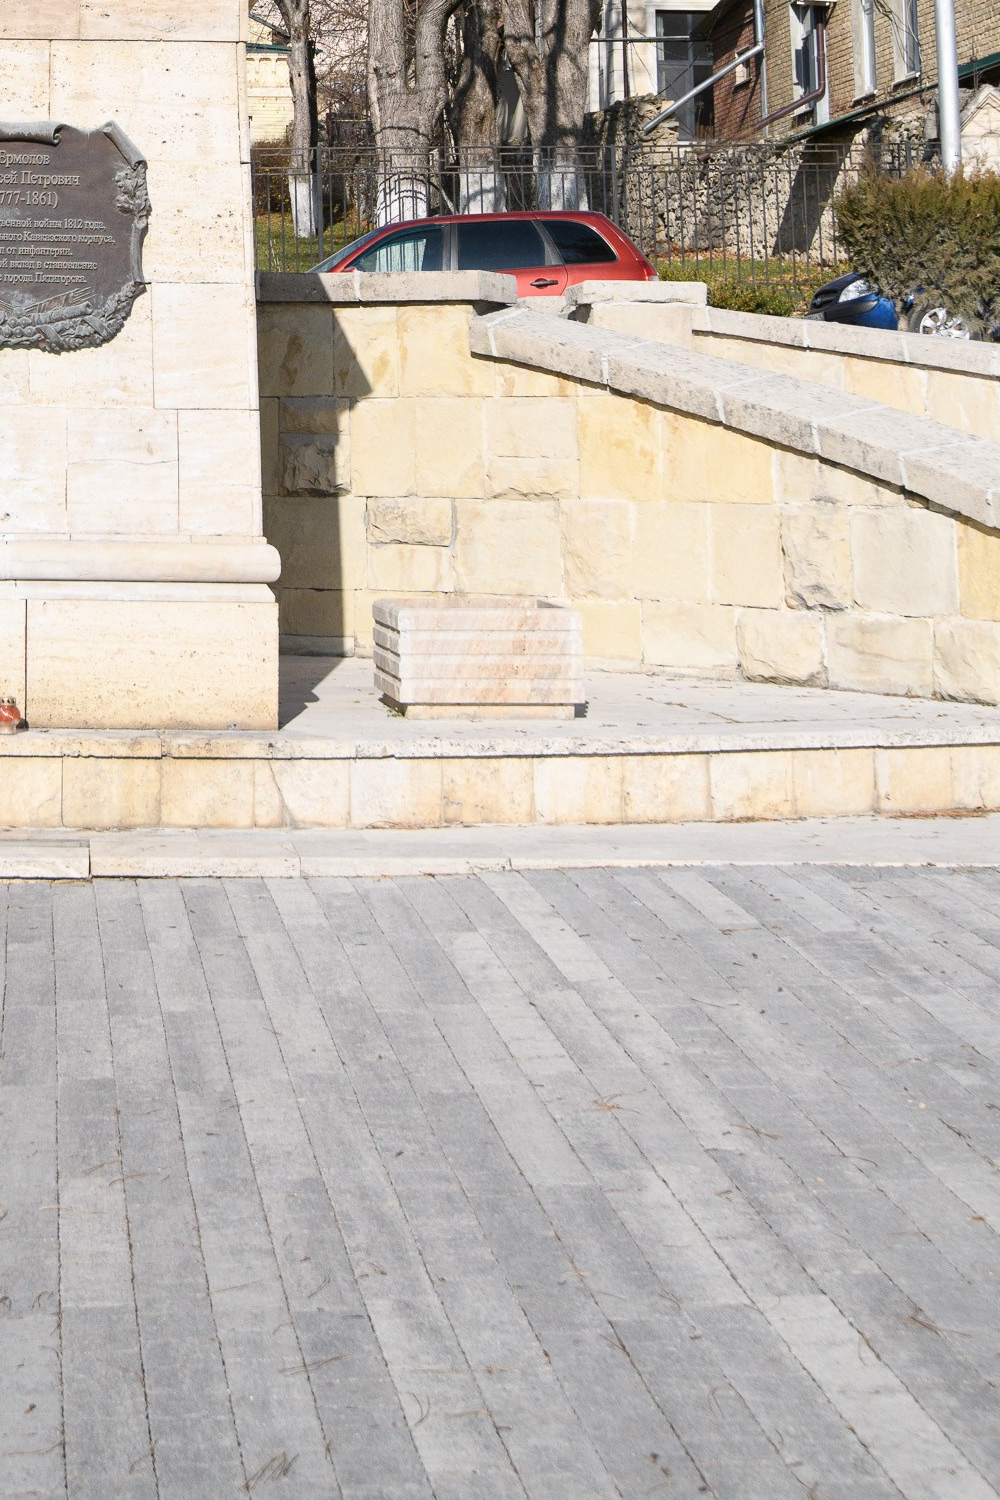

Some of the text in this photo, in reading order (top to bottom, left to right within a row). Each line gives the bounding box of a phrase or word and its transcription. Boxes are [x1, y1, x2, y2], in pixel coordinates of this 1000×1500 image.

[20, 171, 80, 188] Петрович
[34, 218, 62, 229] войны
[64, 219, 83, 229] 1812
[84, 221, 106, 232] года,
[24, 231, 77, 242] Кавказского
[78, 235, 116, 245] корпуса,
[6, 247, 17, 255] от
[18, 245, 74, 258] инфантерии.
[10, 261, 35, 269] вклад
[44, 262, 98, 270] становление
[4, 274, 34, 285] города
[35, 272, 88, 286] Пятигорска.
